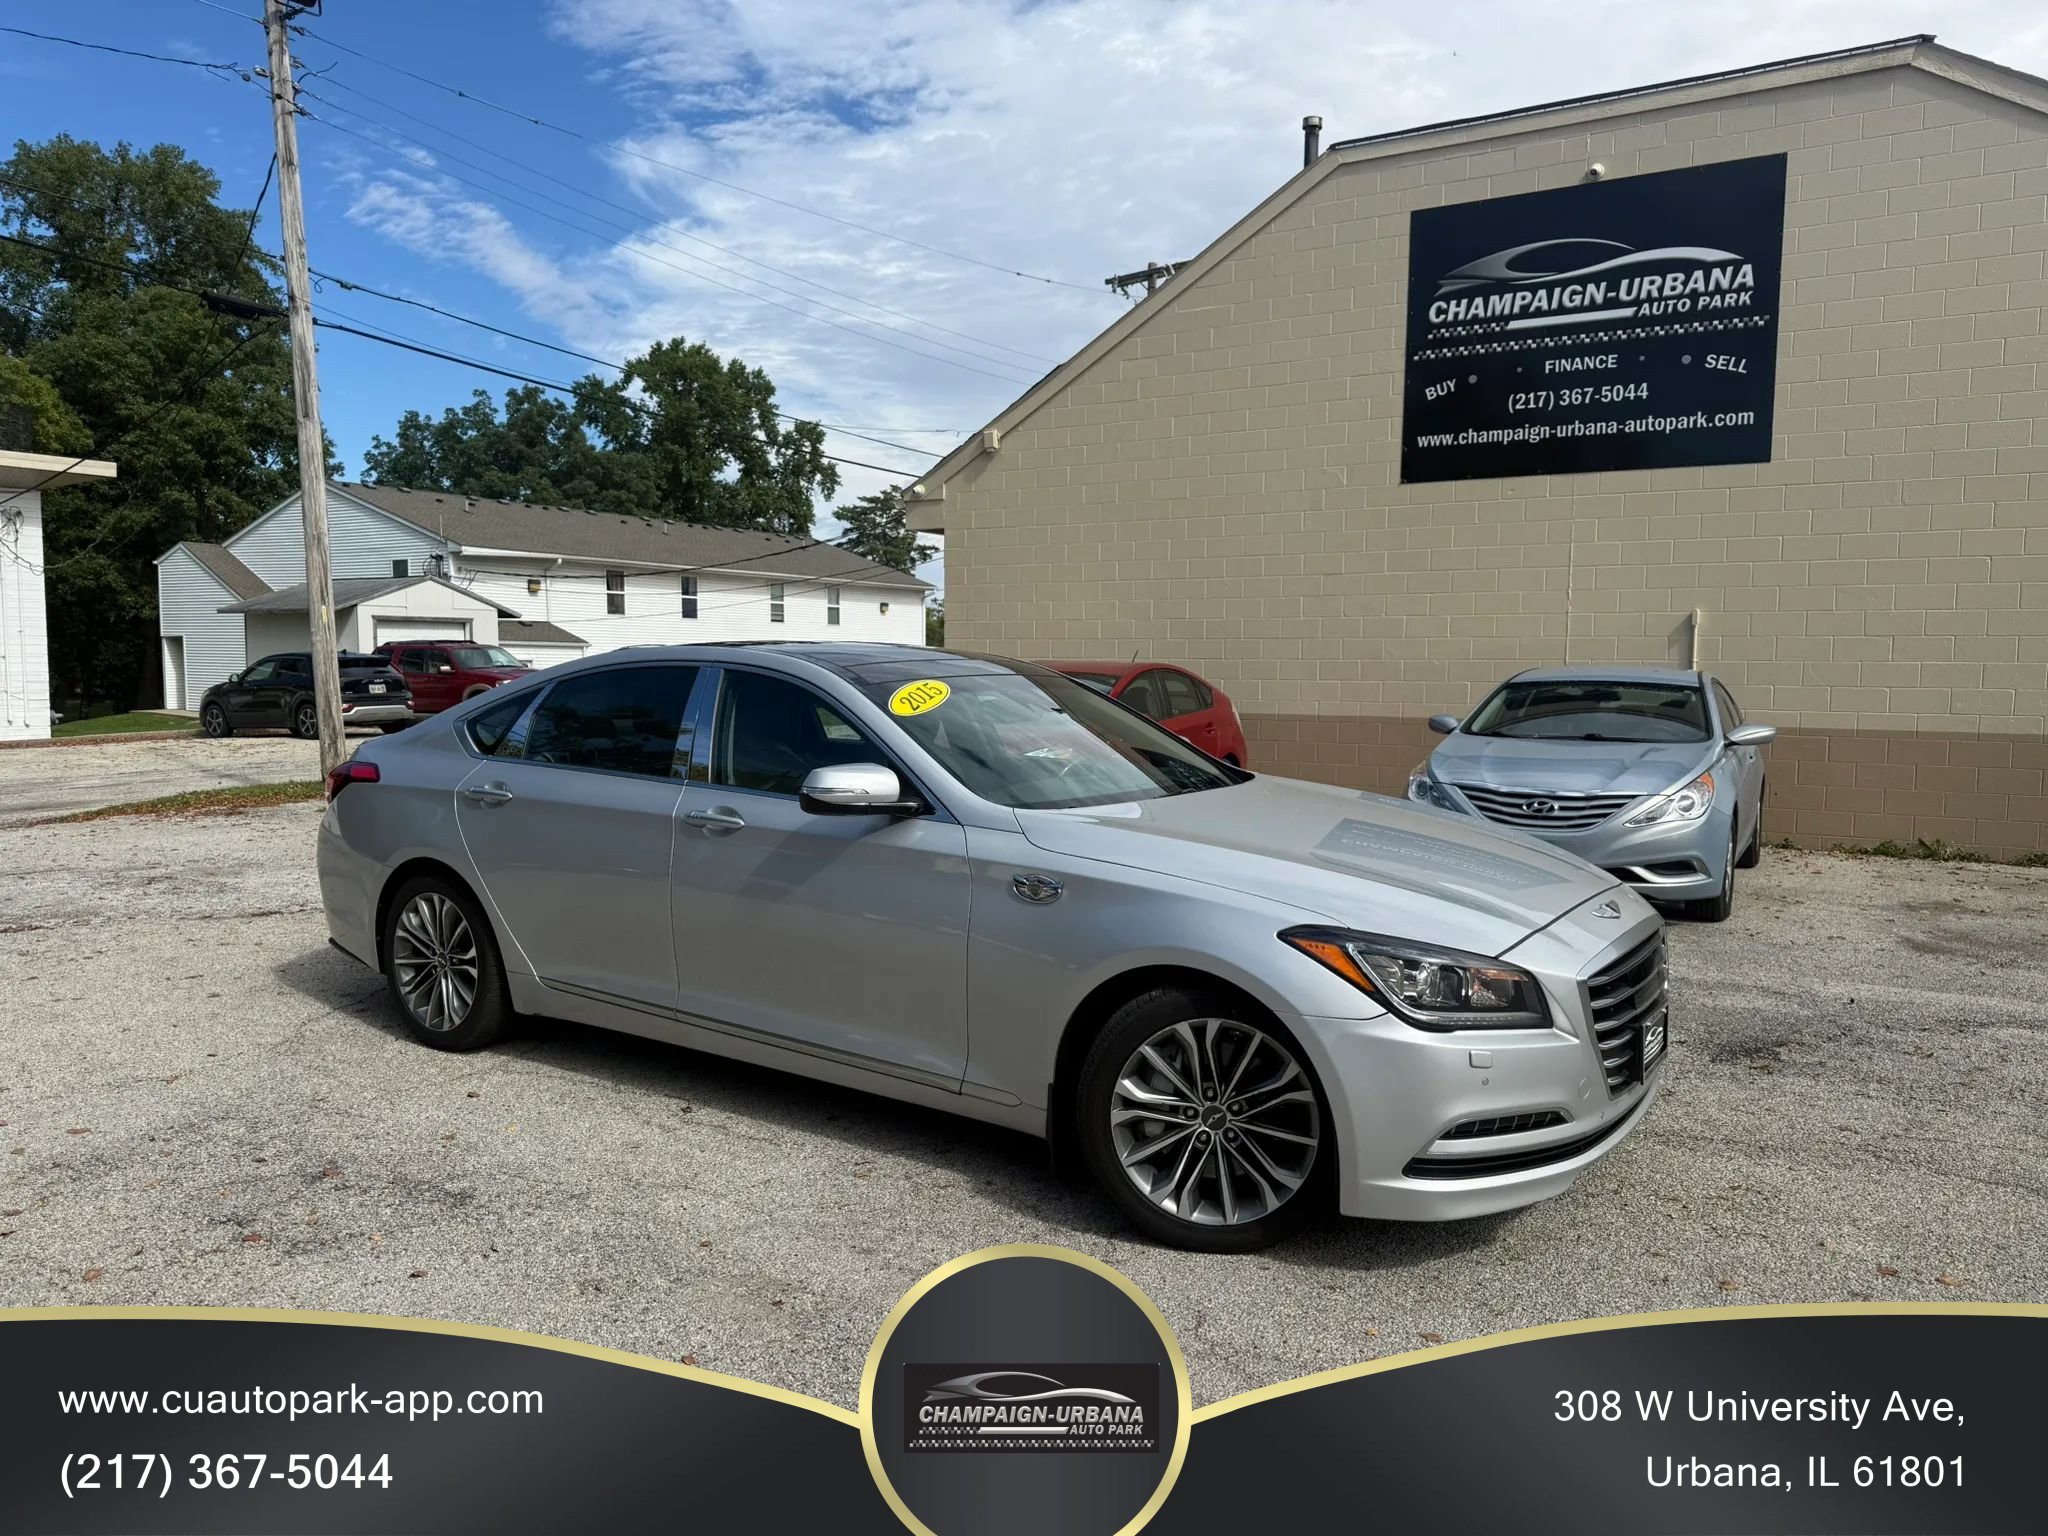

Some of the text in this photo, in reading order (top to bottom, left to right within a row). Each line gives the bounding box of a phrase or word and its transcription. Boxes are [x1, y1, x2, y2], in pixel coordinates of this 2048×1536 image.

[1427, 263, 1755, 324] CHAMPAIGN-URBANA
[1637, 290, 1753, 318] AUTO PARK
[1544, 353, 1619, 374] FINANCE
[1703, 353, 1748, 374] SELL
[1424, 378, 1458, 401] BUY
[1508, 381, 1650, 414] (217) 367-5044
[1416, 410, 1755, 449] www.champaign-urbana-autopark.com
[900, 683, 942, 711] 2015
